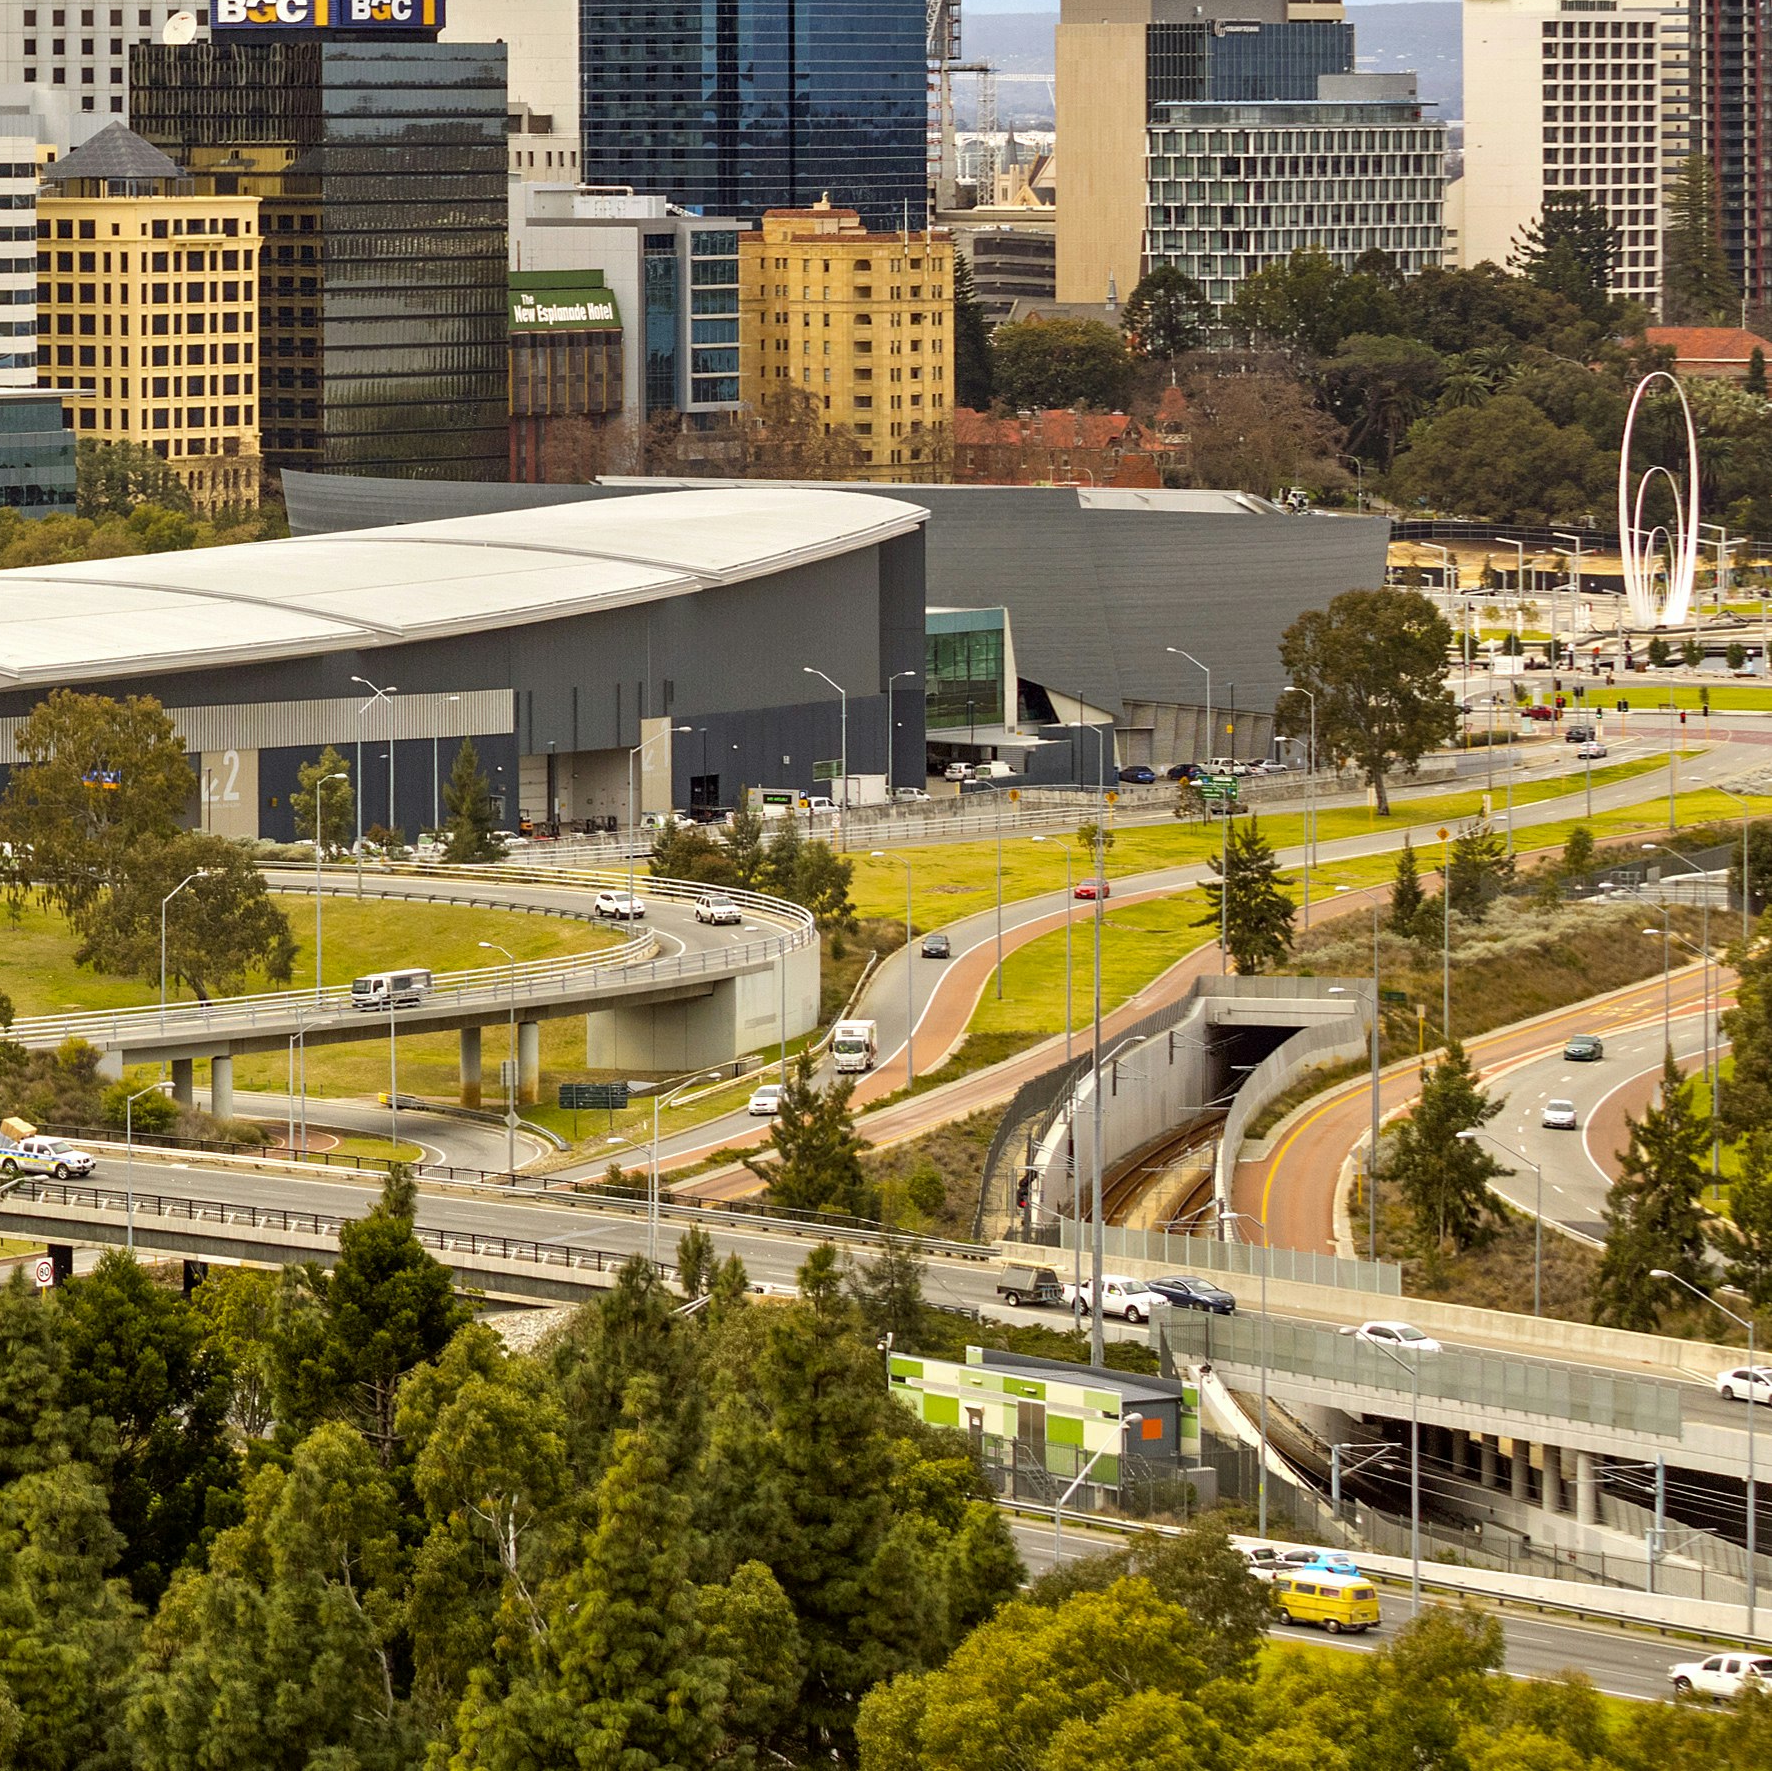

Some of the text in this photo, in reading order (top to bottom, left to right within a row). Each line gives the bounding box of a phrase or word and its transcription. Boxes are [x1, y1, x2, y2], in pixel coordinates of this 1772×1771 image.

[521, 294, 534, 305] The
[514, 302, 613, 325] New Esplanade Hotel
[223, 749, 240, 801] 2
[39, 1266, 50, 1277] 80
